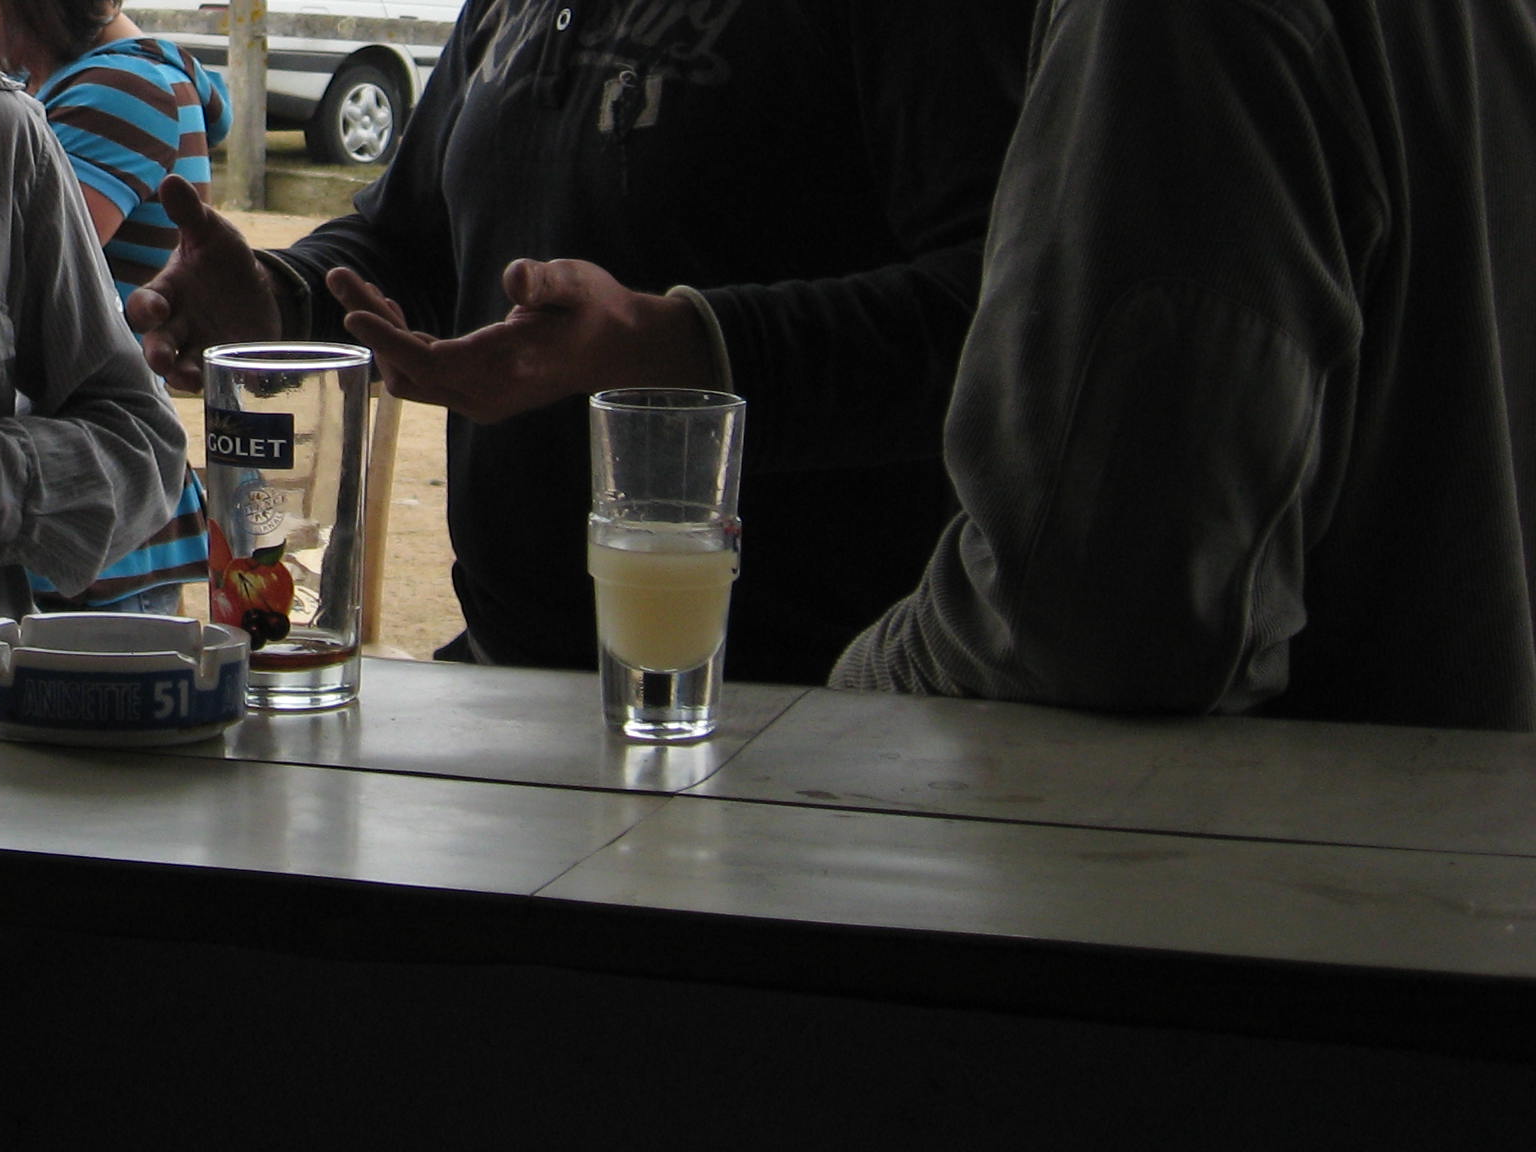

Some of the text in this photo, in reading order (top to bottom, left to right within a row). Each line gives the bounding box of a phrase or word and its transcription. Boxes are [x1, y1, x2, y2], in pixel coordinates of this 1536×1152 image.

[207, 432, 287, 458] GOLET
[21, 678, 142, 721] ANISETTE
[152, 678, 190, 720] 51
